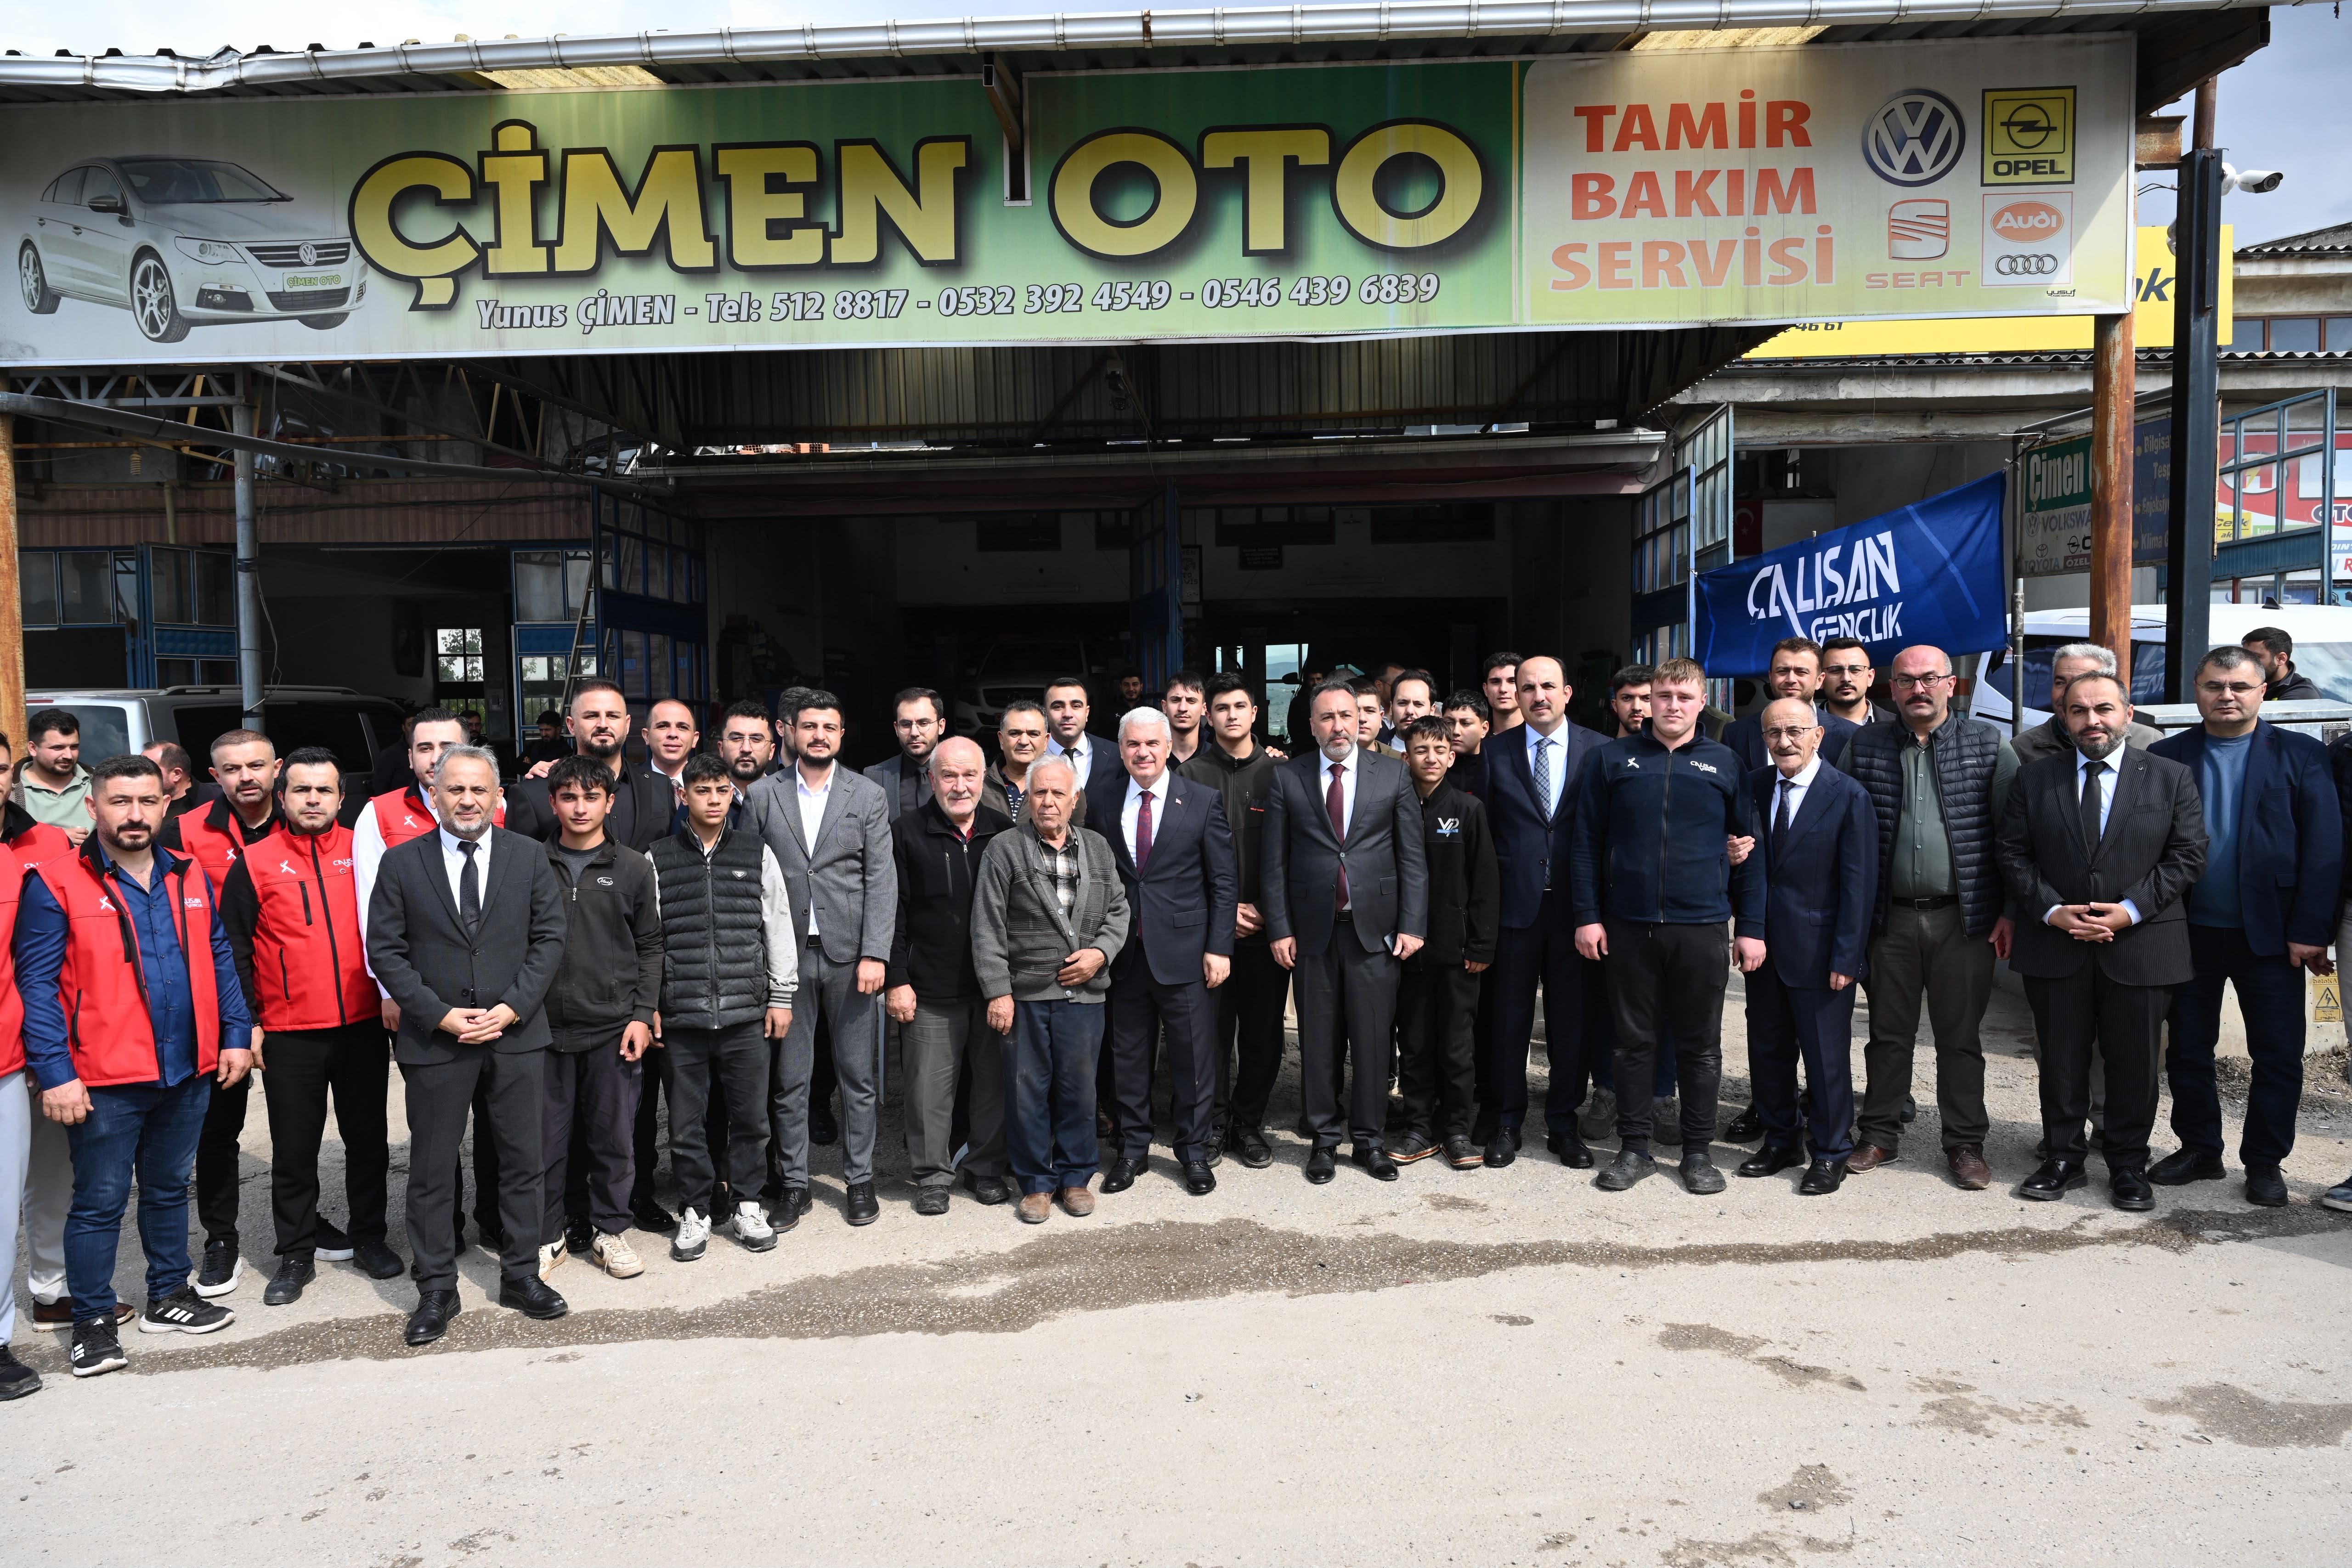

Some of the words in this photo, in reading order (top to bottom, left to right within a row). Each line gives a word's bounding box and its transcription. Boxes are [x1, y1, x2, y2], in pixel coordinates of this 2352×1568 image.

[1574, 89, 1813, 152] TAMİR
[1993, 159, 2065, 176] OPEL
[1571, 167, 1817, 220] BAKIM
[348, 118, 972, 311] ÇİMEN
[1048, 117, 1487, 262] OTO
[1996, 211, 2057, 229] Audi
[1549, 224, 1836, 290] SERVİSİ
[287, 276, 318, 288] ÇİMEN
[319, 275, 341, 285] OTO
[1865, 270, 1971, 289] SEAT
[476, 299, 567, 329] Yunus
[577, 288, 675, 334] ÇİMEN
[706, 291, 762, 323] Tel:
[769, 291, 825, 322] 512
[833, 289, 909, 319] 8817
[938, 285, 1015, 317] 0532
[1023, 283, 1083, 314] 392
[1091, 281, 1171, 311] 4549
[1201, 277, 1281, 309] 0546
[1289, 275, 1351, 306] 439
[1359, 273, 1440, 304] 6839
[2029, 451, 2084, 511] Çimen
[2042, 509, 2091, 533] VOLKSWA
[2024, 557, 2060, 572] TOYOTA
